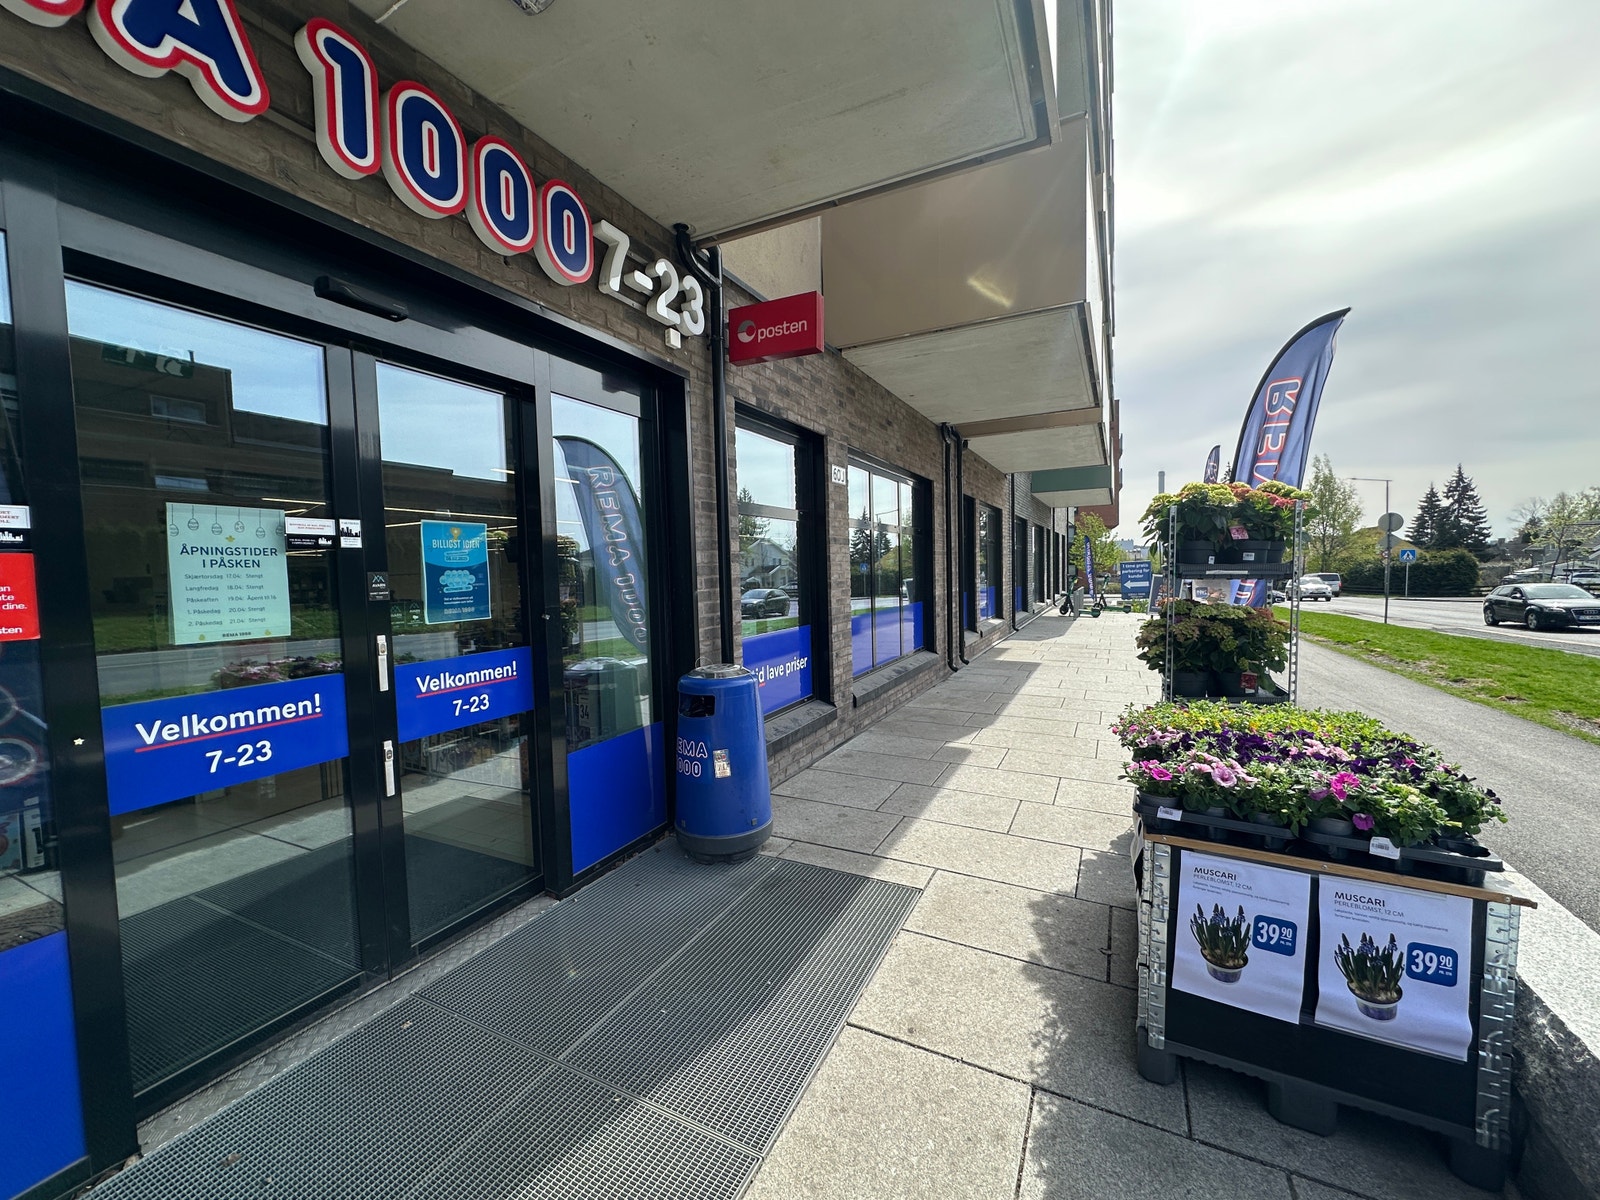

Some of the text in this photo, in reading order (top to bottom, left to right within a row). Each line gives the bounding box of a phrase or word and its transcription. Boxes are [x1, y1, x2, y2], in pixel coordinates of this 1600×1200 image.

[295, 17, 594, 286] 1000
[593, 219, 704, 336] 7-23
[757, 319, 808, 343] posten
[588, 465, 631, 567] REMA
[180, 543, 278, 557] ÅPNINGSTIDER
[432, 539, 460, 549] BILLIGST
[202, 557, 261, 569] I PÅSKEN
[416, 660, 517, 693] Velkommen!
[751, 656, 808, 683] id lave priser
[452, 694, 490, 716] 7-23
[135, 693, 322, 745] Velkommen!
[205, 740, 273, 774] 7-23
[677, 737, 708, 759] EMA
[1193, 867, 1237, 881] MUSCARI
[1334, 891, 1385, 907] MUSCARI
[1256, 921, 1293, 945] 39 90
[1411, 949, 1453, 975] 39 90
